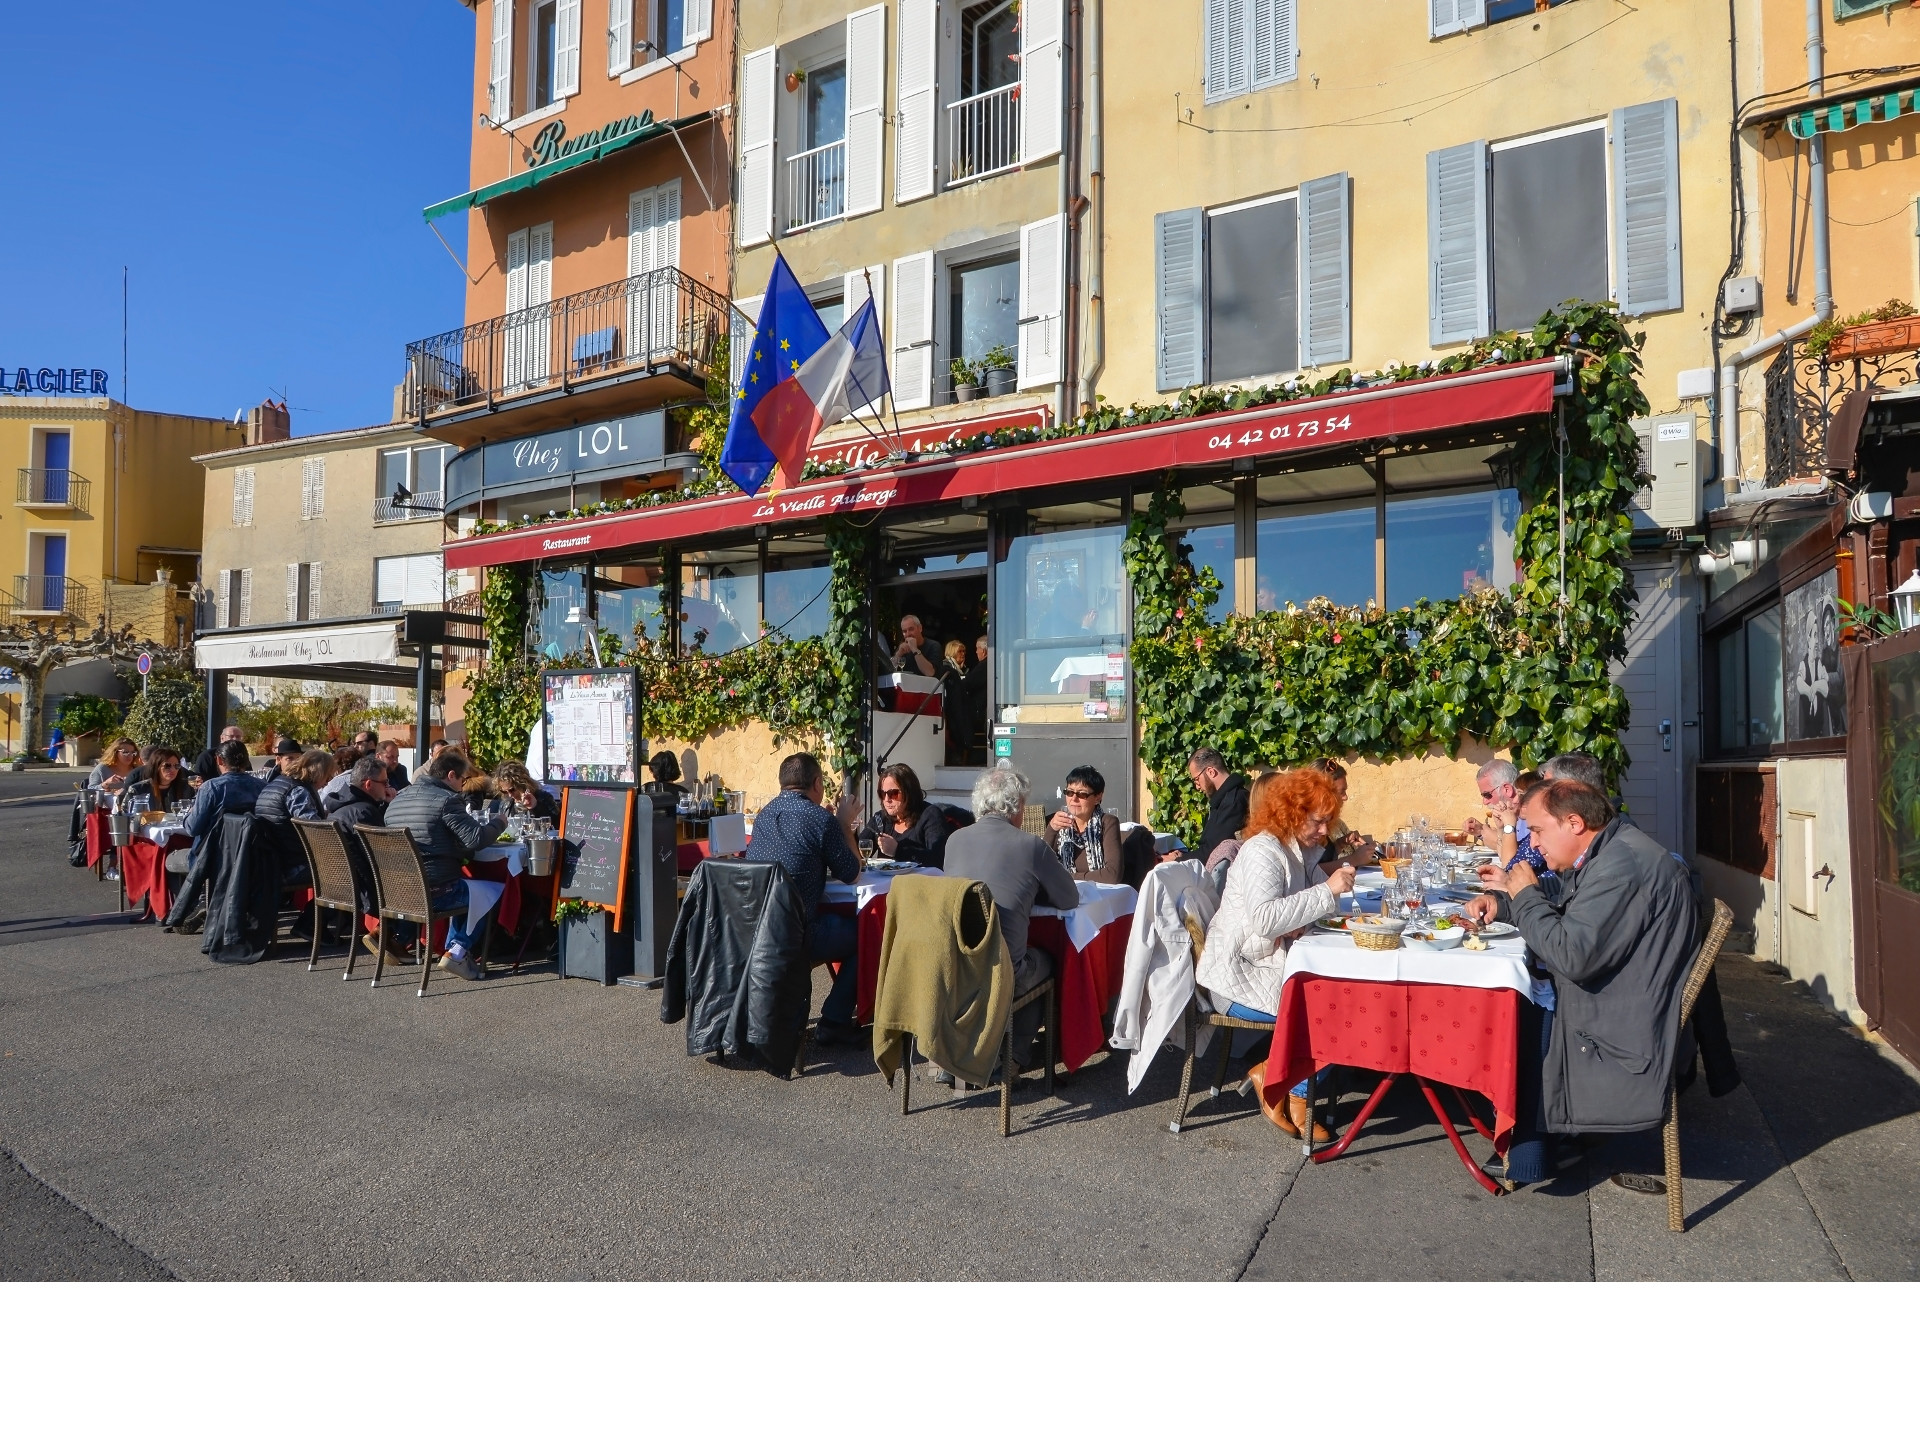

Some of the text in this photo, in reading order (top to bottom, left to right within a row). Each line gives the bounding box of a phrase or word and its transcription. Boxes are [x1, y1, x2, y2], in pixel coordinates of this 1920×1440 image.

[1208, 414, 1352, 449] 04 42 01 73 54
[513, 423, 629, 473] Chez LOL
[752, 487, 898, 518] La Vieille Auberge
[542, 534, 592, 551] Restaurant
[248, 639, 333, 661] Restaurant Chez LOL
